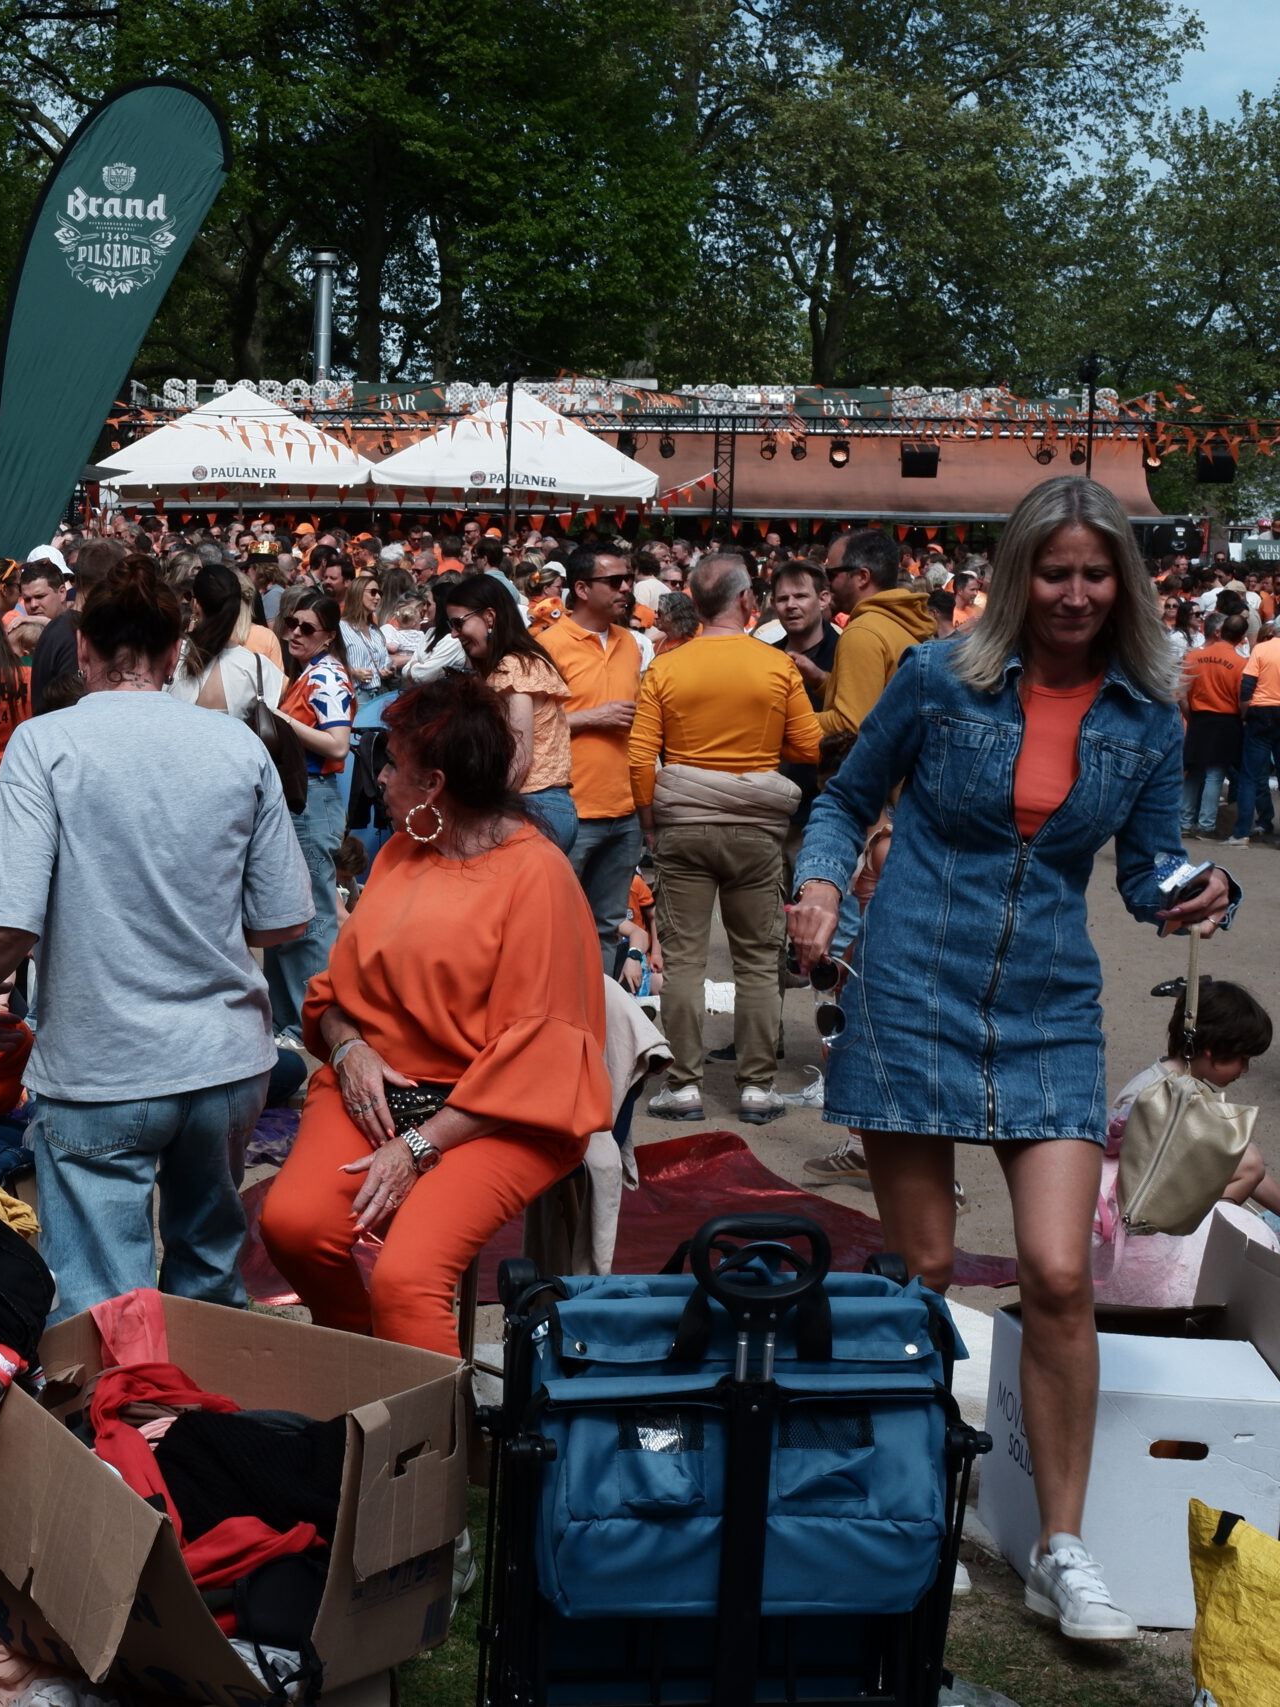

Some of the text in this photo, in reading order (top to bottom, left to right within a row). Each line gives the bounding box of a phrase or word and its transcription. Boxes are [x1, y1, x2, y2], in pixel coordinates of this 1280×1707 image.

[67, 186, 168, 222] Brand
[101, 231, 129, 242] 1340
[77, 243, 152, 268] PILSENER
[380, 394, 416, 410] BAR
[823, 399, 862, 416] BAR
[211, 467, 277, 479] PAULANER
[1197, 656, 1235, 671] HOLLAND
